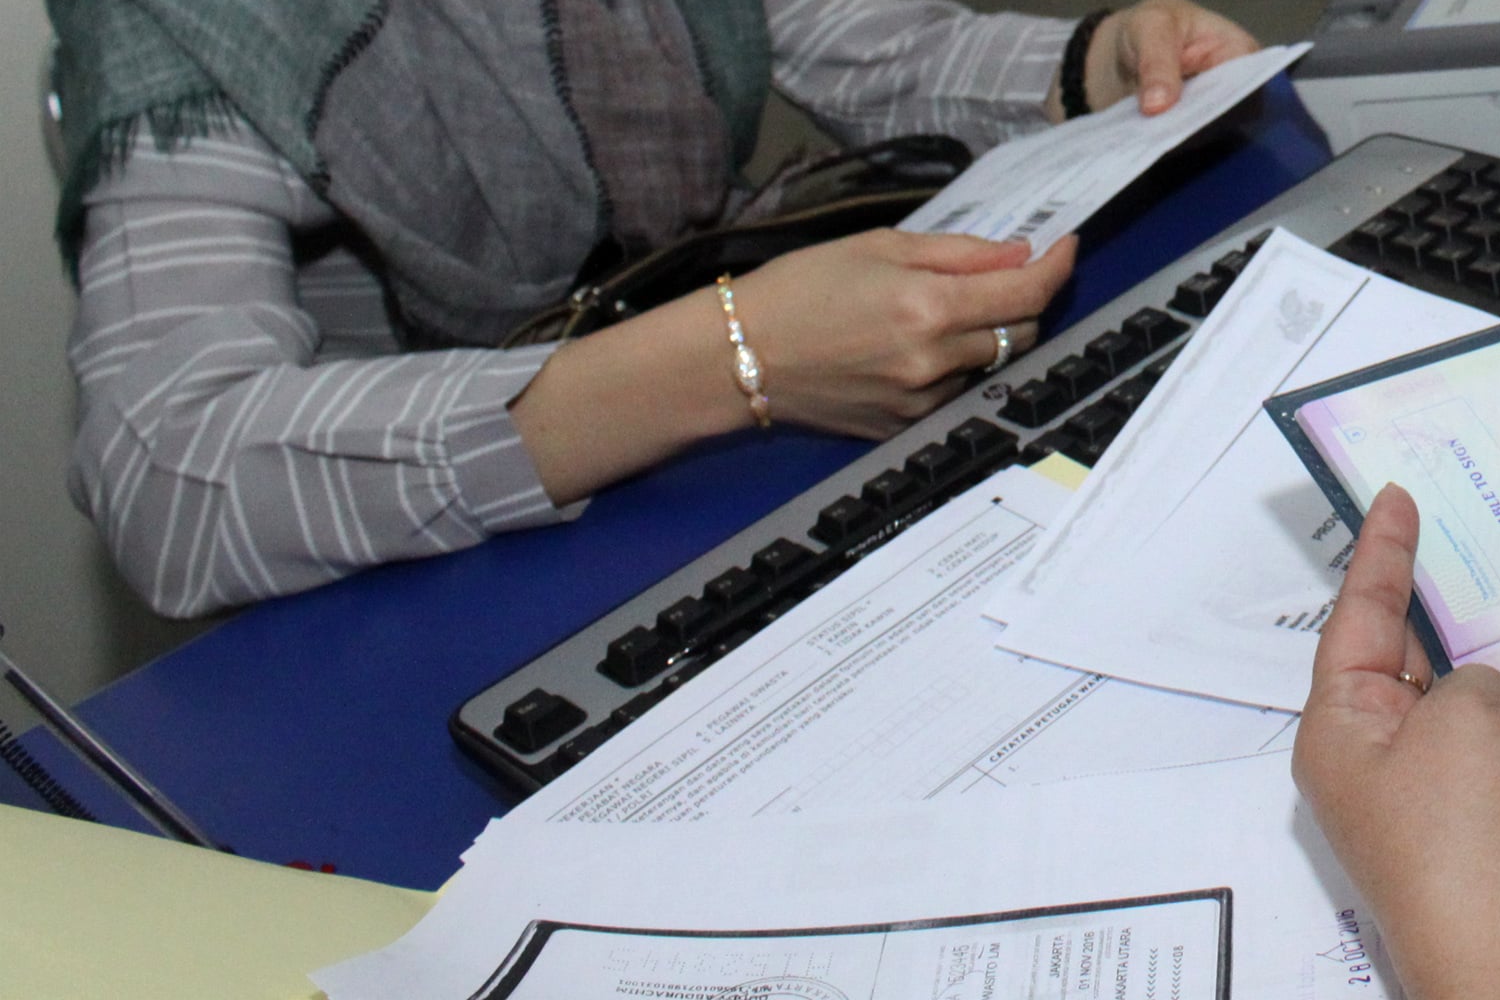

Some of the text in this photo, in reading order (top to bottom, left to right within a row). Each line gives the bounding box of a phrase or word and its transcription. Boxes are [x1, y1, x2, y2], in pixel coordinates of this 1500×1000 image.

[1449, 439, 1476, 470] SIGN
[1469, 472, 1487, 490] TO
[706, 697, 750, 730] PEGAWAI
[750, 671, 788, 698] SWASTA
[989, 727, 1035, 763] CATATAN
[1034, 694, 1079, 728] PETUGAS
[632, 765, 671, 794] NEGERI
[671, 748, 698, 767] SIPIL
[705, 756, 726, 772] data
[578, 761, 662, 822] PEJABAT NEGARA
[621, 789, 653, 815] POLRI
[1049, 934, 1064, 978] JAKARTA
[1078, 930, 1095, 990] 01 NOV 2016
[1115, 926, 1132, 1000] AKARTA UTARA
[1340, 938, 1365, 961] OCT
[1348, 963, 1371, 985] 28
